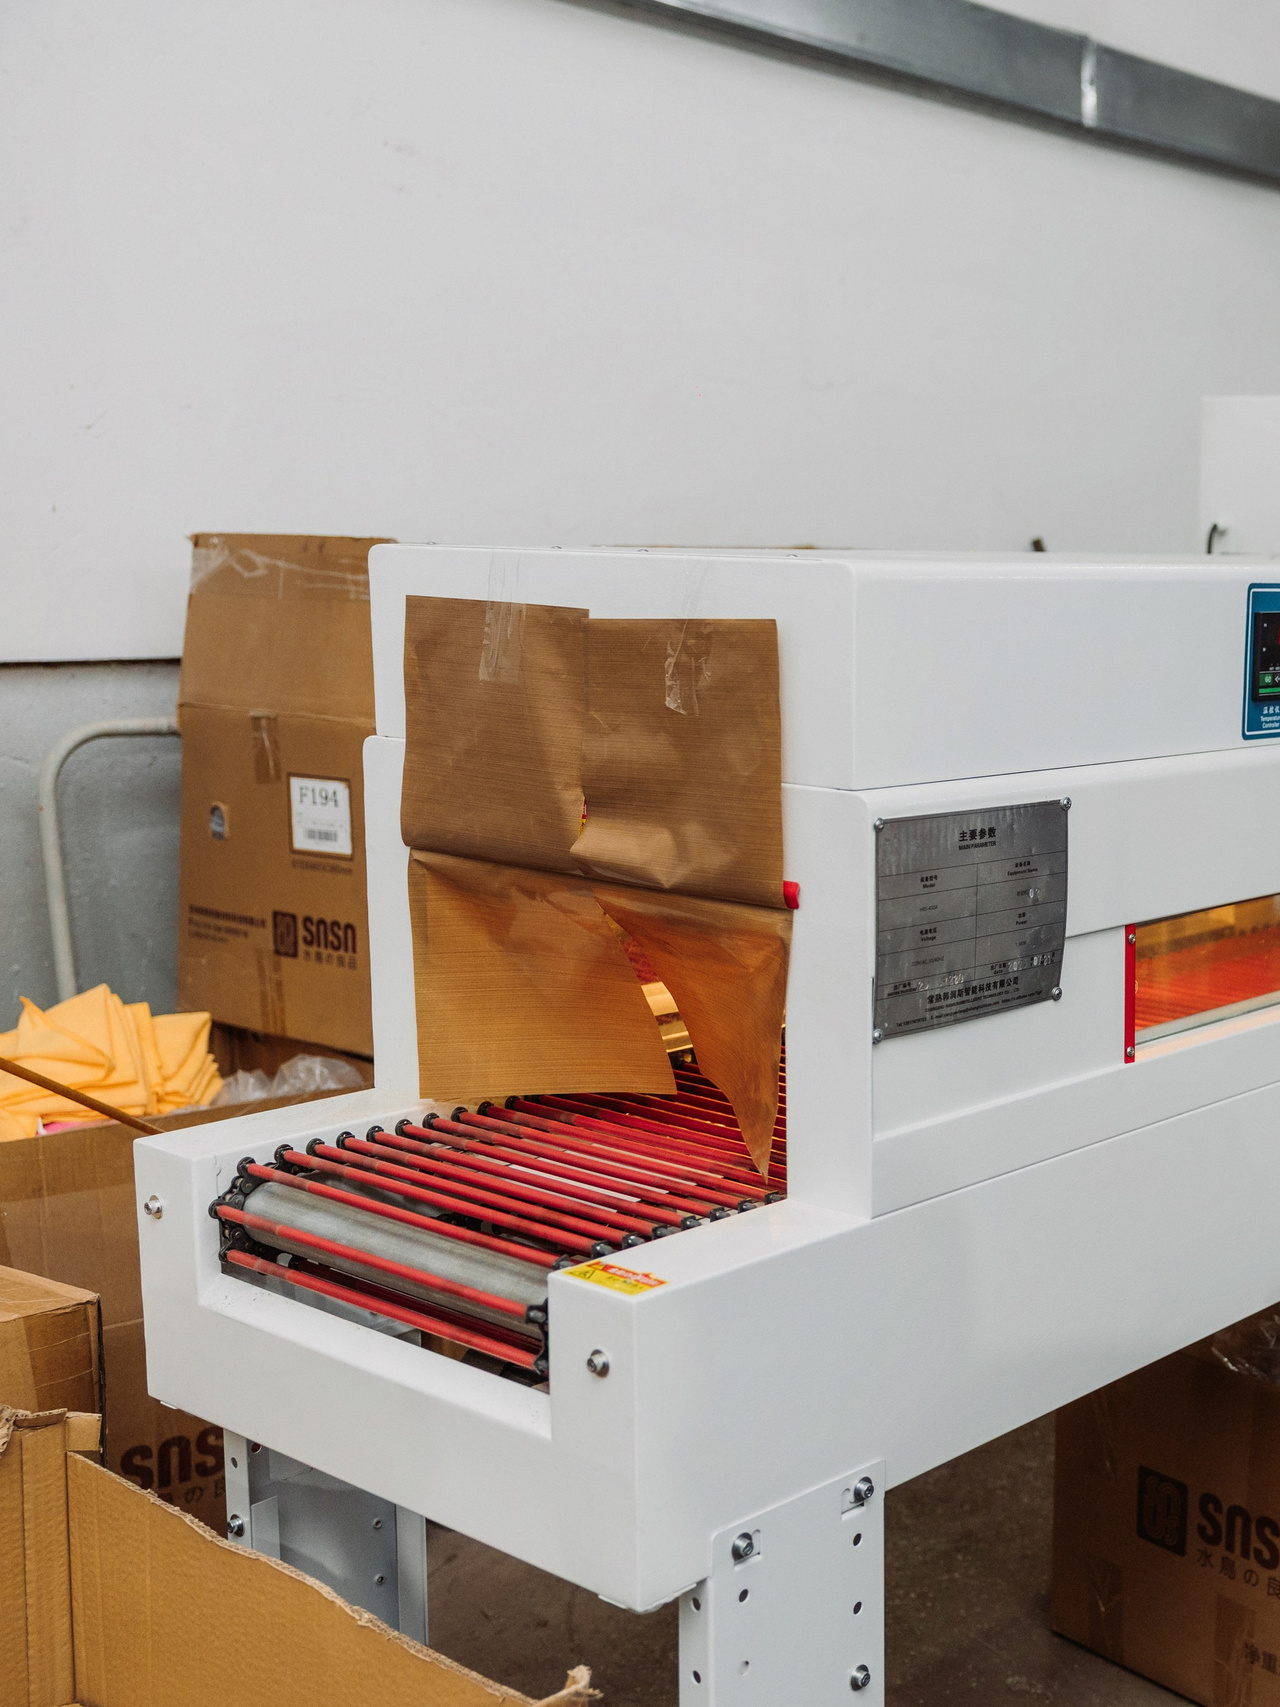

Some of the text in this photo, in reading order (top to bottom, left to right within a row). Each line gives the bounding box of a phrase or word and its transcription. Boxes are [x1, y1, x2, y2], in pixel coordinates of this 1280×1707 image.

[298, 785, 339, 808] F194
[958, 826, 996, 842] 主要参数
[958, 840, 996, 851] MAIN PARAMETER
